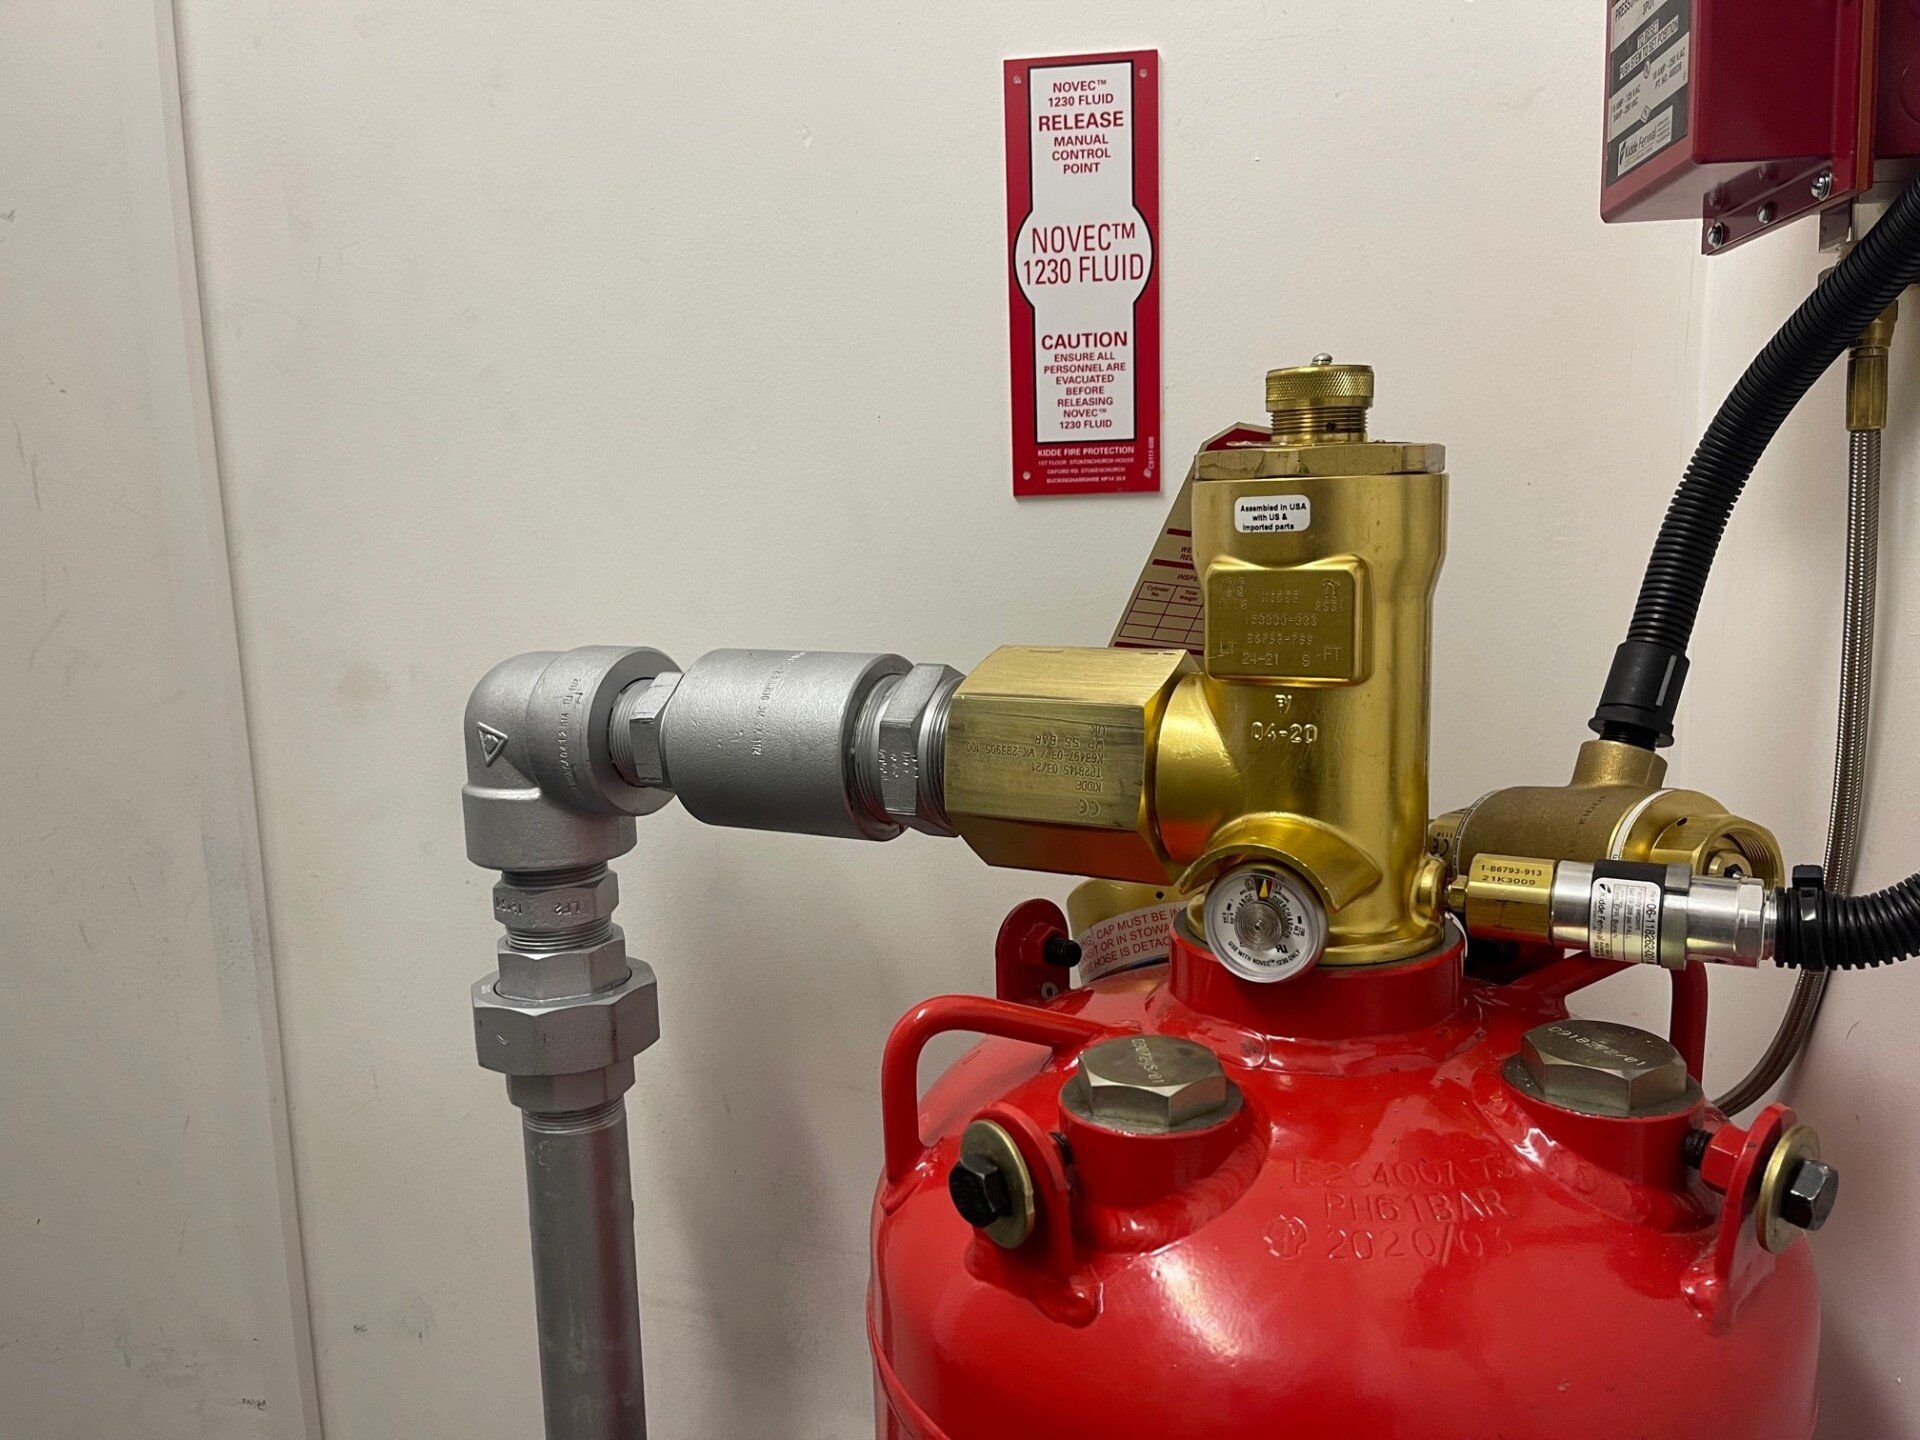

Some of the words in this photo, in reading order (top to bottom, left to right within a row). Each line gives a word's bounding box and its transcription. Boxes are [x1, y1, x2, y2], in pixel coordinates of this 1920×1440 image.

[1048, 96, 1075, 107] 1230
[1078, 93, 1114, 106] FLUID
[1038, 111, 1124, 131] RELEASE
[1054, 134, 1109, 146] MANUAL
[1052, 148, 1111, 160] CONTROL
[1063, 162, 1100, 174] POINT
[1024, 258, 1071, 285] 1230
[1079, 254, 1144, 283] FLUID
[1041, 331, 1128, 350] CAUTION
[1054, 353, 1095, 362] ENSURE
[1097, 352, 1115, 360] ALL
[1044, 364, 1104, 374] PERSONNEL
[1106, 362, 1126, 372] ARE
[1055, 374, 1114, 385] EVACUATED
[1066, 386, 1104, 396] BEFORE
[1057, 397, 1113, 407] RELEASING
[1059, 421, 1081, 430] 1230
[1084, 419, 1112, 428] FLUID
[1038, 449, 1061, 457] KIDDE
[1064, 448, 1080, 456] FIRE
[1083, 446, 1134, 455] PROTECTION
[1240, 504, 1278, 512] Assembled
[1243, 524, 1273, 532] imported
[1275, 523, 1294, 531] parts
[1091, 724, 1106, 736] UK
[1034, 734, 1058, 747] BAR
[1065, 736, 1080, 748] 55
[1088, 738, 1105, 750] WP
[1032, 762, 1059, 774] 03/21
[1076, 780, 1102, 793] KIDDE
[1483, 875, 1536, 885] 21K3009
[1598, 892, 1608, 914] Kidde
[1096, 925, 1115, 939] CAP
[1117, 914, 1148, 931] MUST
[1151, 911, 1169, 922] BE
[1596, 915, 1605, 941] Fenwal
[1100, 939, 1115, 951] OR
[1117, 934, 1127, 945] IN
[1228, 941, 1238, 952] USE
[1238, 950, 1252, 961] WITH
[1288, 949, 1301, 962] ONLY
[1094, 950, 1118, 969] HOSE
[1120, 947, 1131, 957] IS
